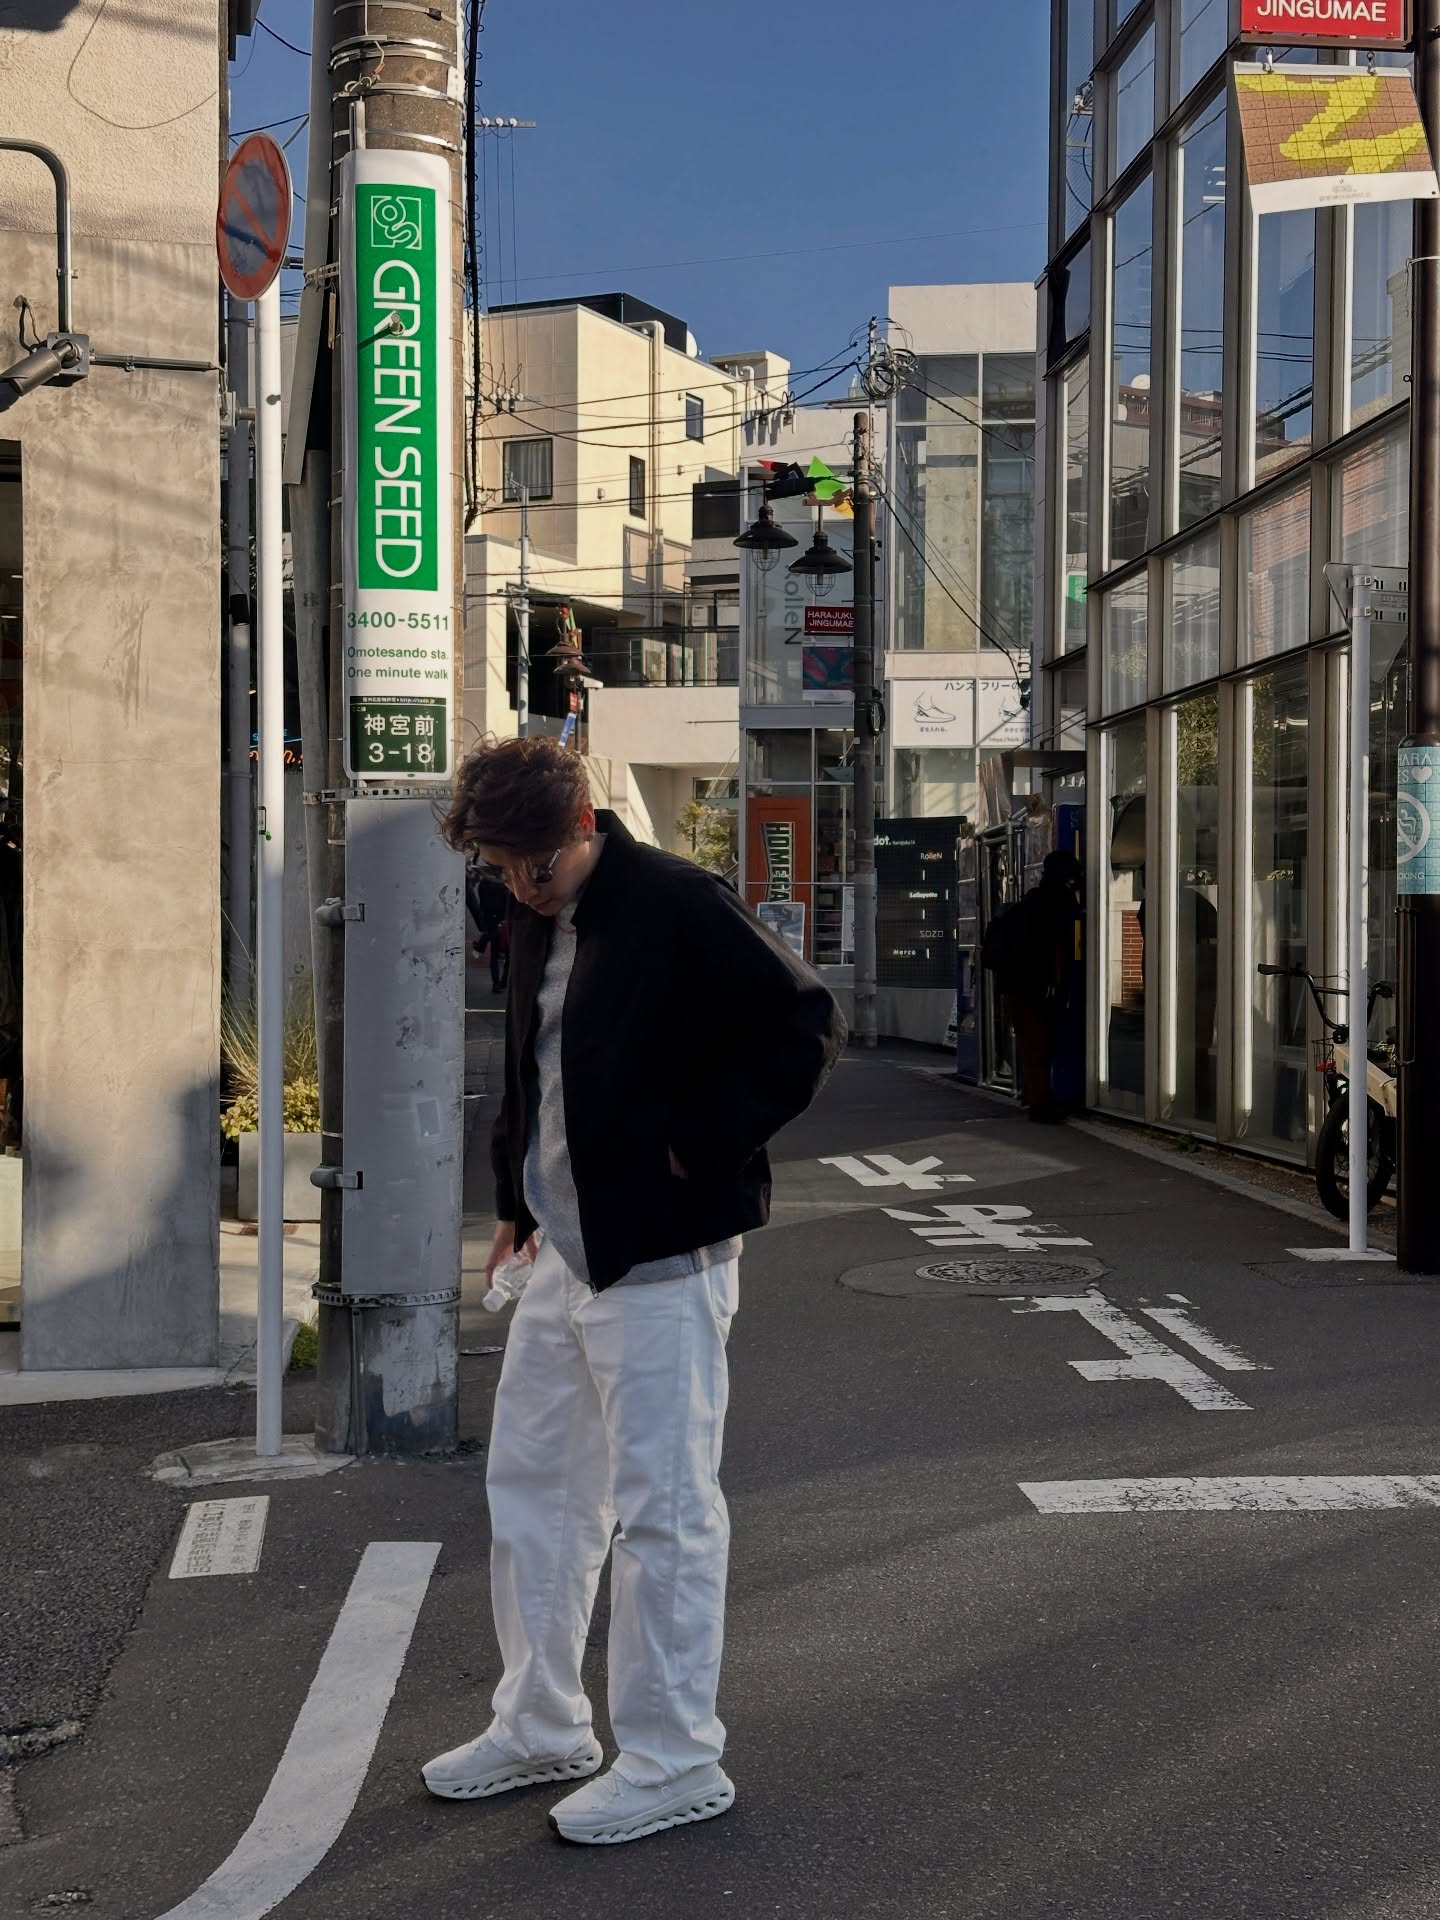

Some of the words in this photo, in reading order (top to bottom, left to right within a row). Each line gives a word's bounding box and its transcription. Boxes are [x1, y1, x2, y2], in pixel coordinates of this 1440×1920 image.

[1257, 0, 1387, 22] JINGUMAE
[373, 259, 421, 434] GREEN
[375, 446, 422, 578] SEED
[347, 612, 449, 631] 3400-5511
[809, 619, 854, 627] JINGUMAE
[348, 646, 427, 658] Omotesando
[431, 648, 449, 660] sta.
[348, 667, 372, 678] One
[376, 667, 421, 678] minute
[425, 669, 449, 680] walk
[364, 714, 434, 736] 神宮前
[368, 742, 432, 764] 3-18
